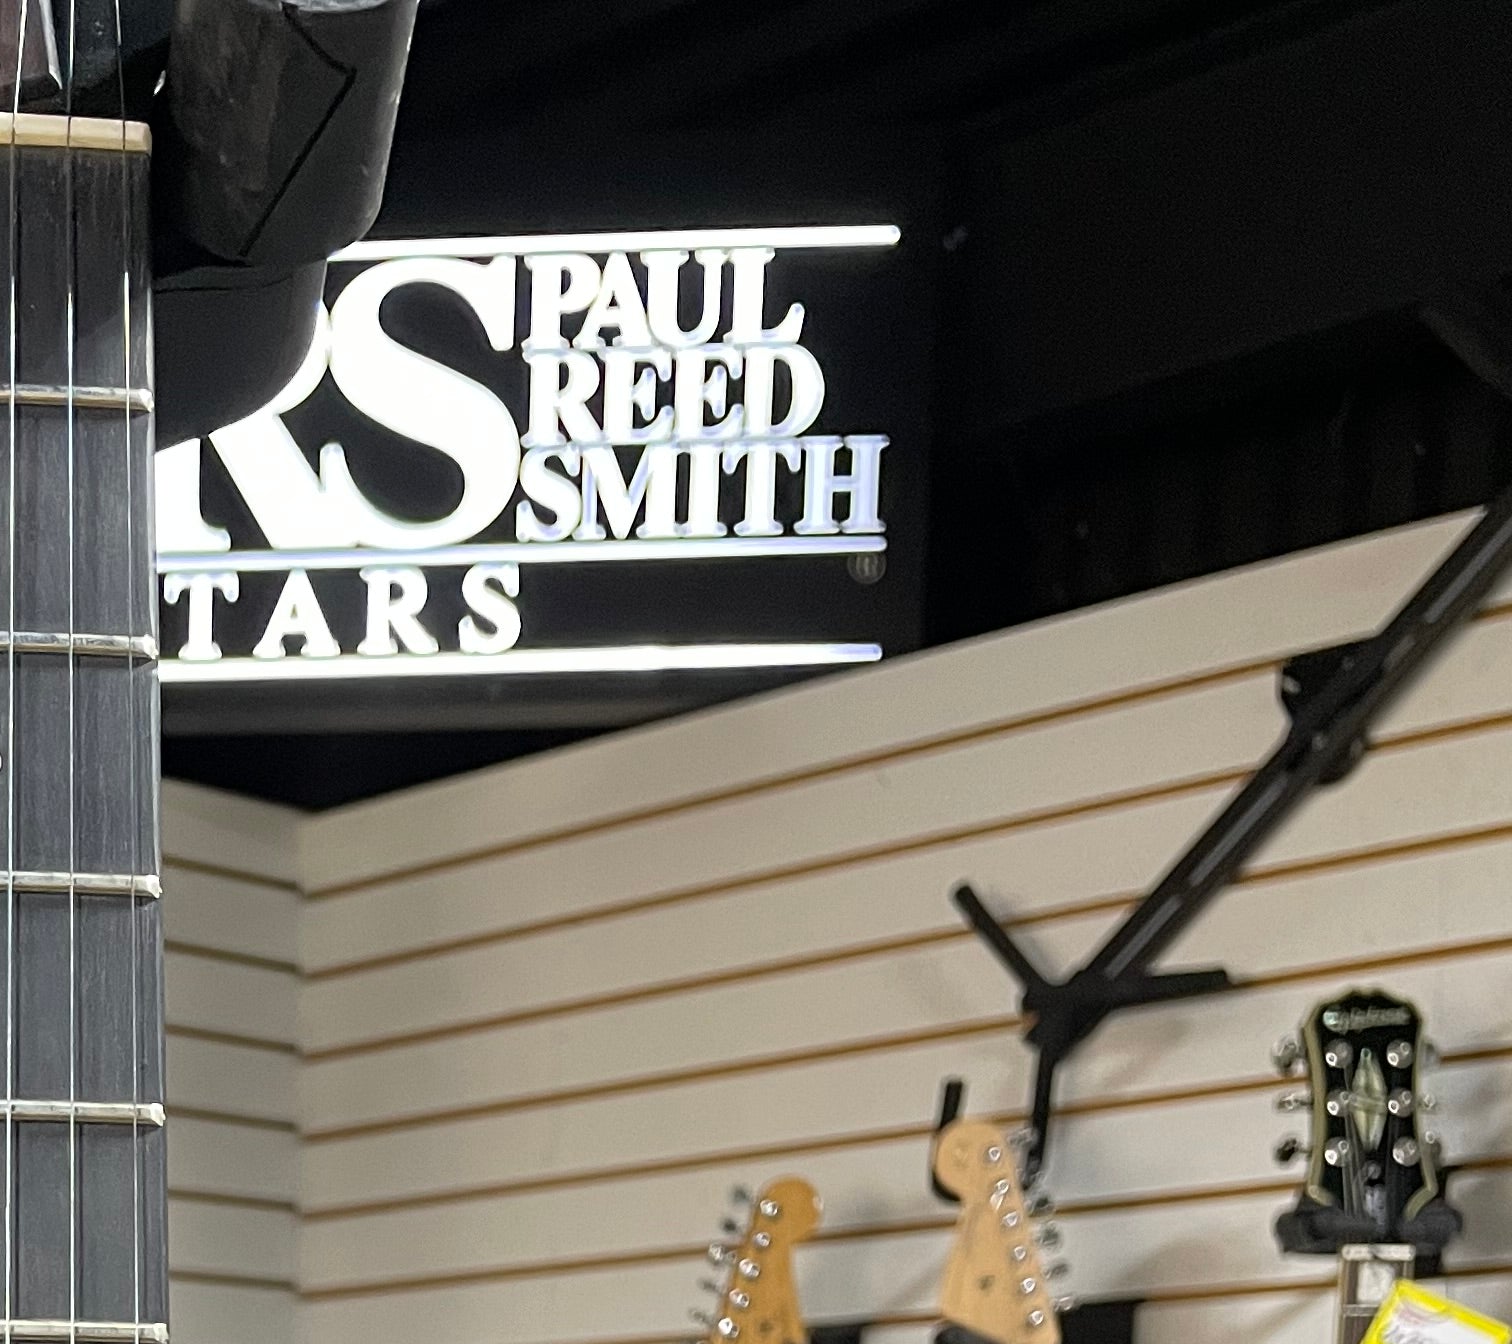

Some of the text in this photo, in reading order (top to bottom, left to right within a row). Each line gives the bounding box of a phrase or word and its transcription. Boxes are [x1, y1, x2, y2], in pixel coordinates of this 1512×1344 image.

[524, 246, 804, 352] PAUL
[521, 343, 826, 449] REED
[515, 434, 890, 544] SMITH
